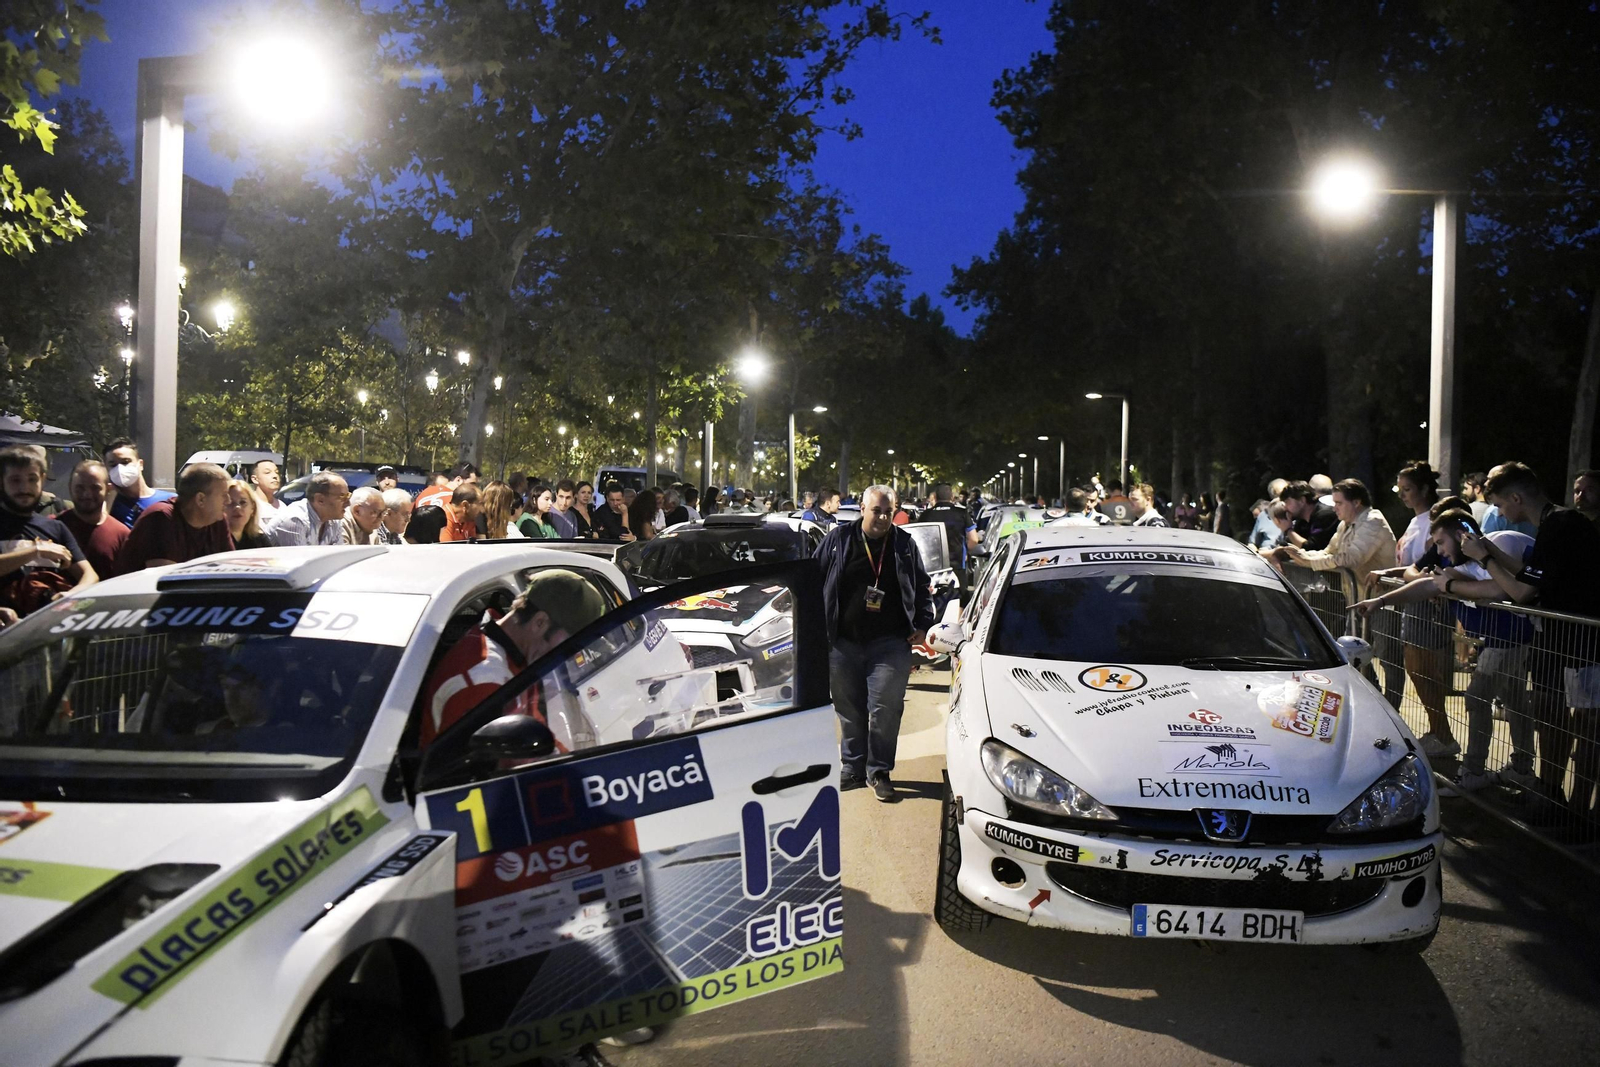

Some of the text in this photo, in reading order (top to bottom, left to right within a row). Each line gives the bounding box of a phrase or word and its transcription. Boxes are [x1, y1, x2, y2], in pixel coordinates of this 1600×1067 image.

[1114, 505, 1127, 519] 9
[1089, 551, 1208, 565] KUMHO TYRE
[49, 606, 360, 634] SAMSUNG SSD
[1095, 687, 1190, 717] Chapa y Pintura
[1167, 723, 1255, 734] INGEOBRAS
[1195, 710, 1221, 724] FG
[456, 754, 704, 853] 1 Boyacá
[1138, 777, 1311, 805] Extremadura
[401, 835, 438, 863] SSD
[987, 824, 1074, 861] KUMHO TYRE
[525, 839, 591, 878] ASC
[1150, 849, 1262, 875] Servicopa
[1357, 848, 1435, 878] KUMHO TYRE
[1136, 909, 1298, 942] E 6414 BDH
[489, 1024, 550, 1060] SOL
[559, 1001, 634, 1042] SALE
[638, 973, 738, 1017] TODOS
[746, 956, 796, 989] LOS
[803, 943, 843, 973] DIA
